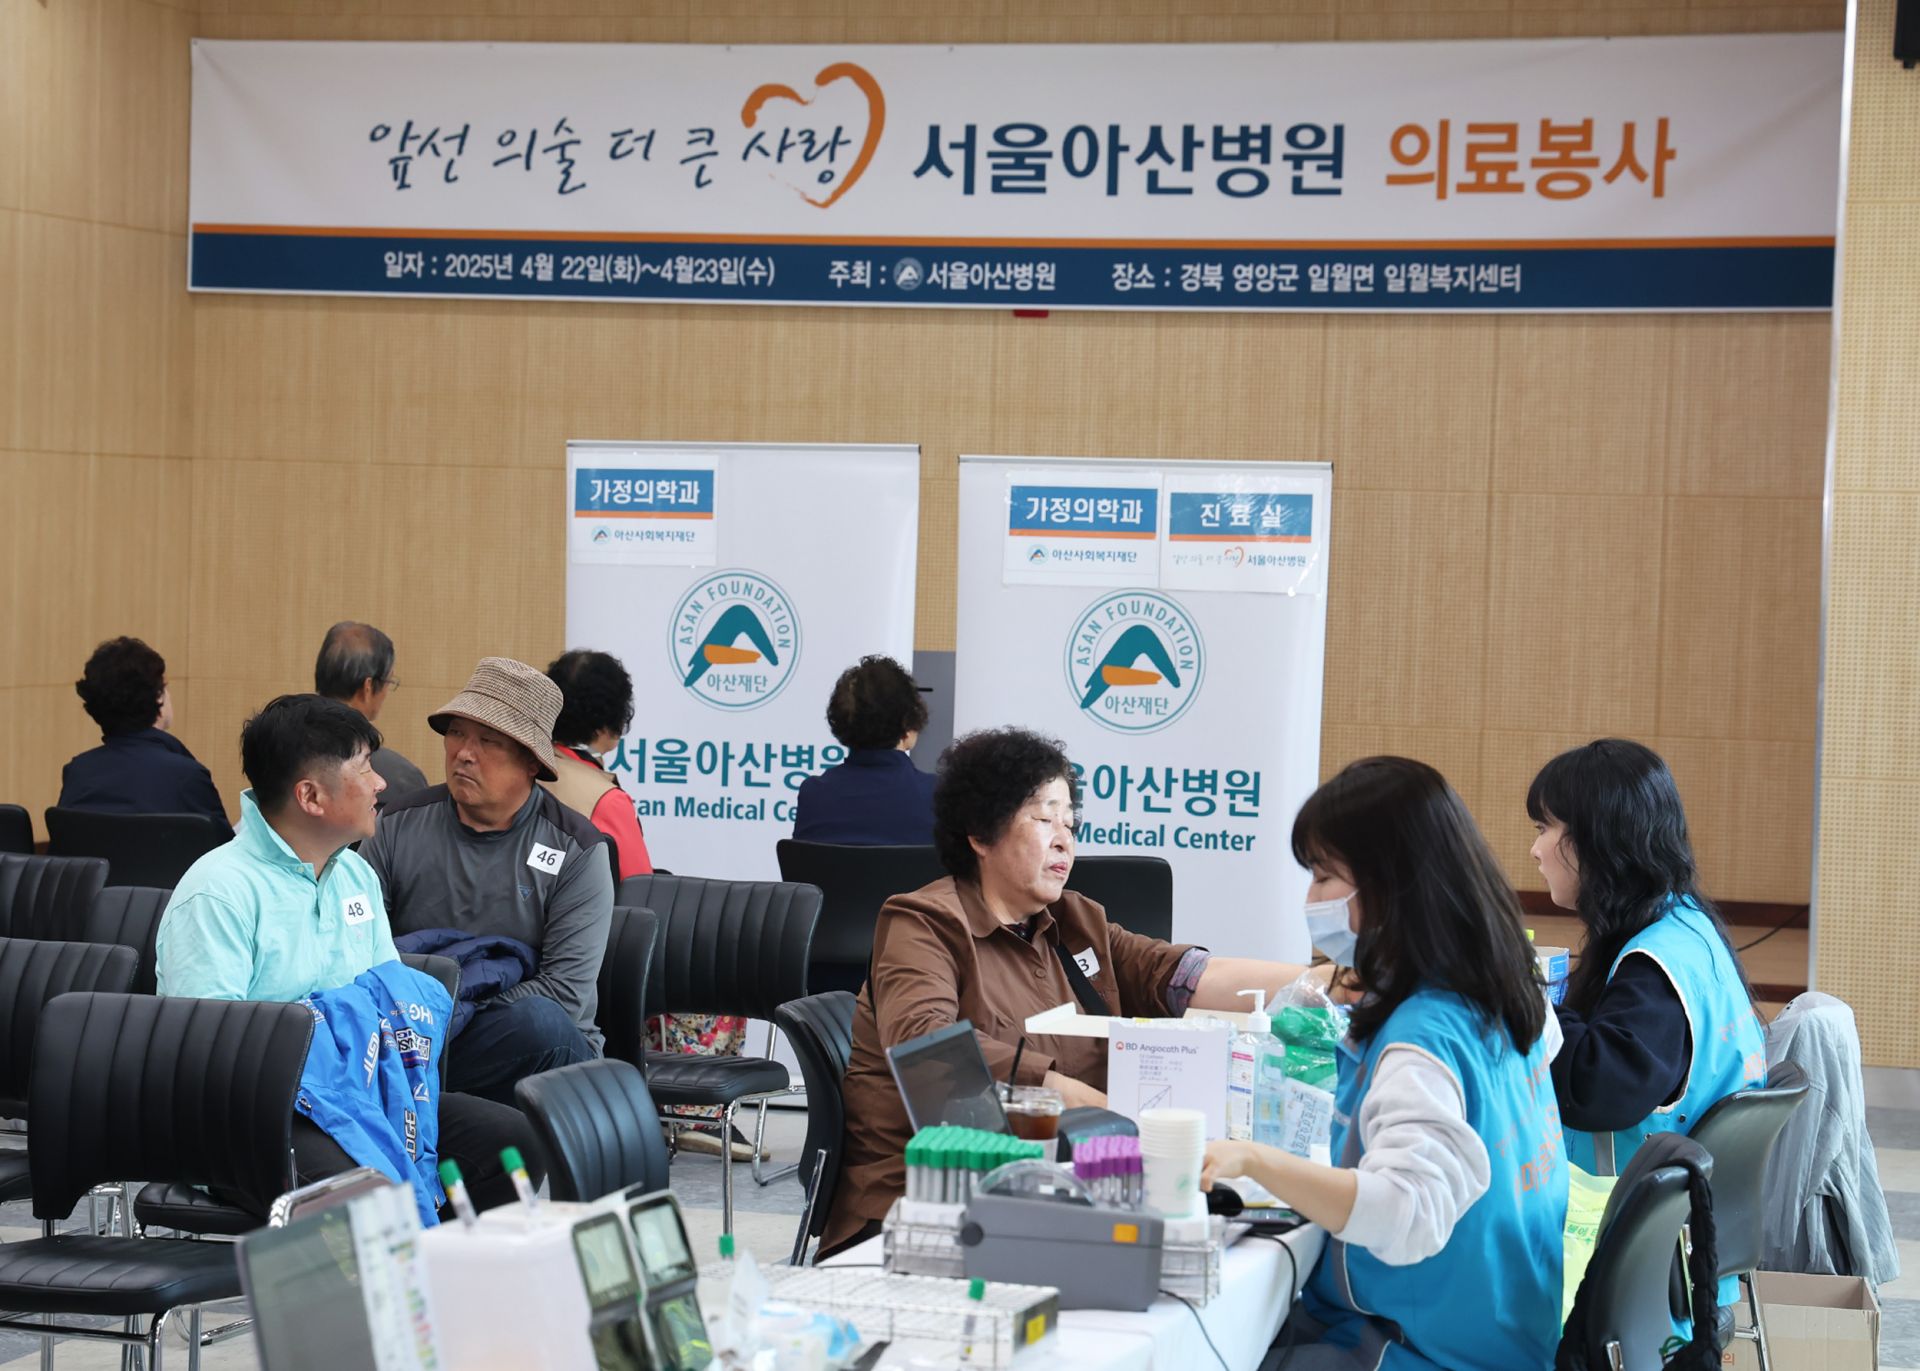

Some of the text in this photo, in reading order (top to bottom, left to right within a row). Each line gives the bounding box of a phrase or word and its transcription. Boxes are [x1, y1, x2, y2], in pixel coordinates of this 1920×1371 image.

[370, 117, 851, 194] 앞선 의술 더 큰 사랑
[912, 116, 1678, 201] 서울아산병원 의료봉사
[384, 251, 424, 279] 일자
[444, 253, 513, 280] 2025년
[520, 254, 553, 282] 4월
[561, 254, 775, 286] 22일(화)~4월23일(수)
[828, 260, 872, 289] 주최
[926, 261, 1056, 292] 서울아산병원
[1112, 262, 1156, 291] 장소
[1180, 263, 1224, 292] 경북
[1233, 264, 1299, 293] 영양군
[1308, 264, 1375, 293] 일월면
[1384, 264, 1522, 293] 일월복지센터
[589, 478, 701, 504] 가정의학과
[1025, 496, 1143, 525] 가정의학과
[614, 530, 696, 543] 아산사회복지재단
[1052, 549, 1138, 563] 아산사회복지재단
[680, 580, 791, 649] ASAN FOUNDATION
[1076, 600, 1194, 670] ASAN FOUNDATION
[706, 673, 768, 693] 아산재단
[1104, 695, 1169, 716] 아산재단
[674, 795, 765, 821] Medical
[1173, 826, 1256, 852] Center
[536, 850, 557, 866] 46
[347, 901, 365, 918] 48
